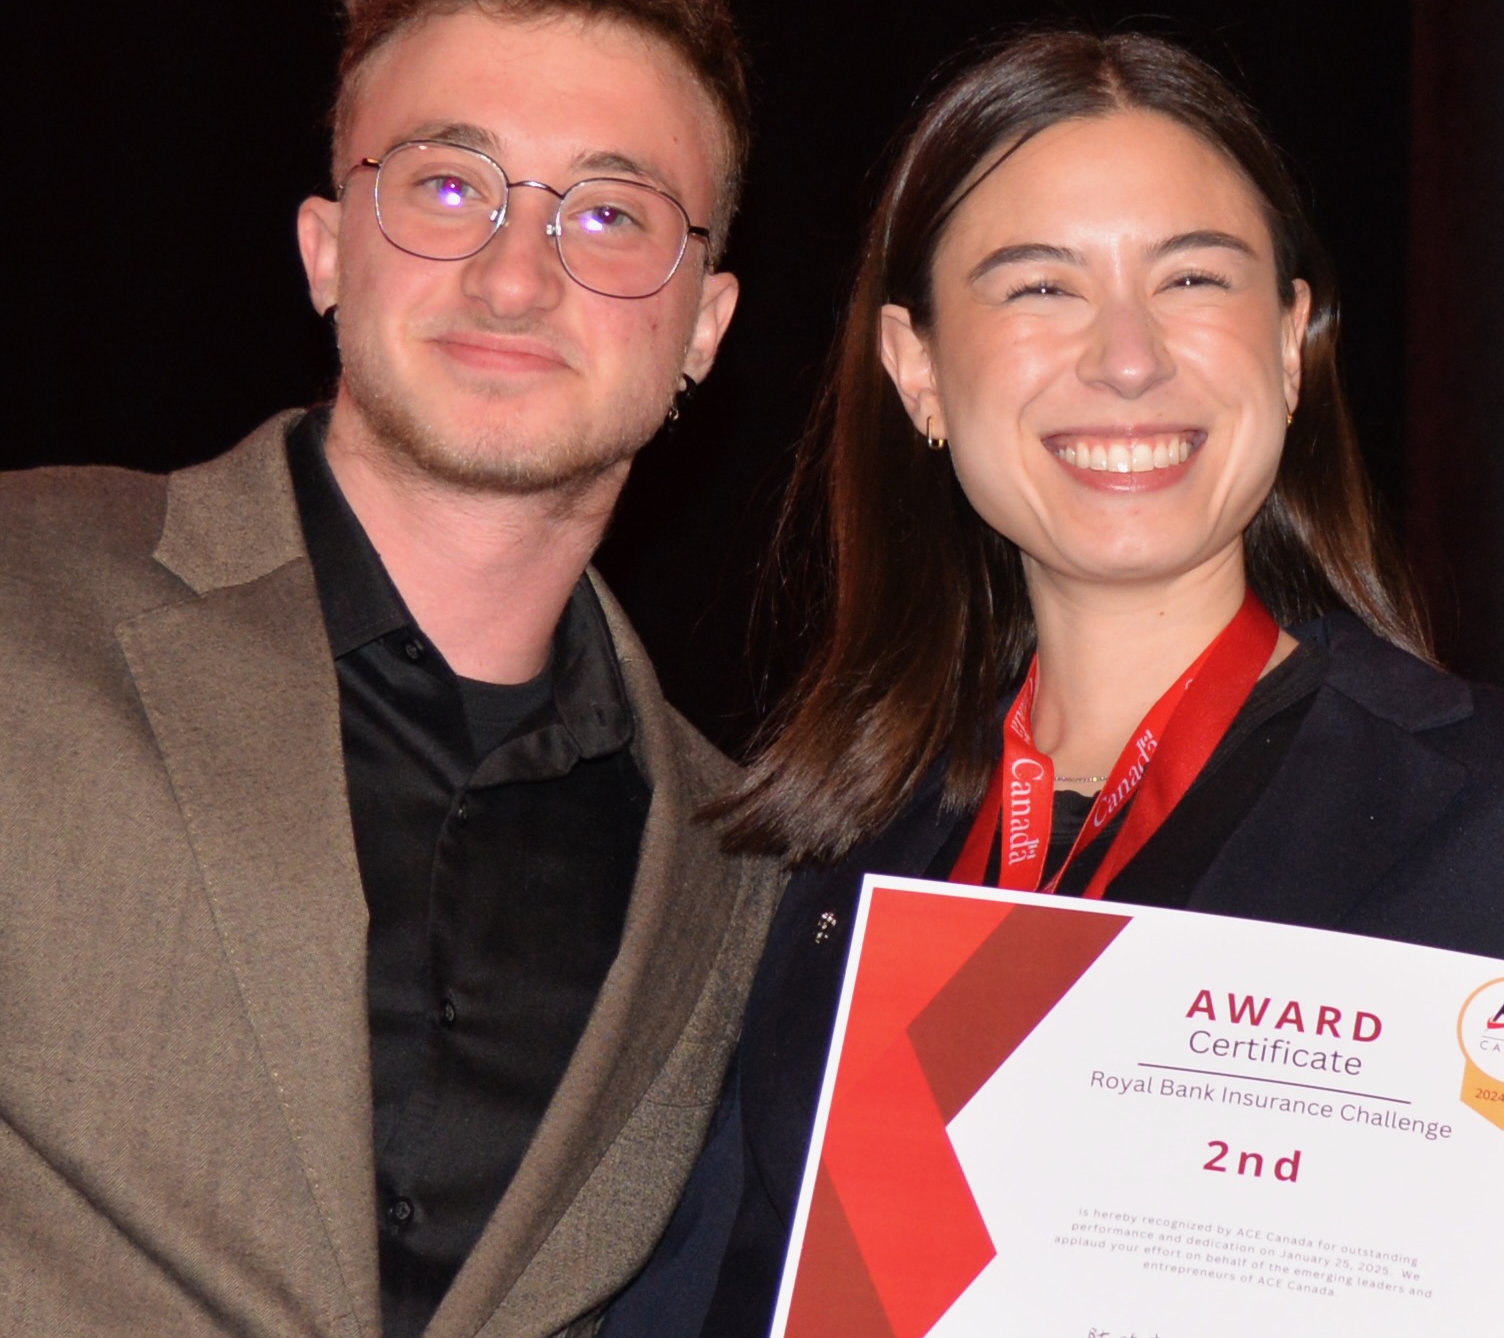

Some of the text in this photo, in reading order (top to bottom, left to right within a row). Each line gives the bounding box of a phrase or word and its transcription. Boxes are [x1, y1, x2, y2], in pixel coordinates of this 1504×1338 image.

[1009, 757, 1045, 866] Canada
[1186, 988, 1383, 1043] AWARD
[1188, 1029, 1363, 1076] Certificate
[1090, 1070, 1453, 1141] Royal Bank Insurance Challenge
[1202, 1140, 1301, 1183] 2nd
[1054, 1236, 1432, 1298] applaud your effort on behalf of the emerging leaders and
[1071, 1222, 1154, 1239] performance
[1158, 1233, 1182, 1243] and
[1186, 1236, 1255, 1254] dedication
[1260, 1247, 1275, 1256] on
[1280, 1250, 1331, 1267] January
[1335, 1258, 1353, 1270] 25,
[1401, 1270, 1420, 1281] We
[1079, 1208, 1418, 1267] is hereby recognized by ACE Canada for outstanding
[1143, 1261, 1235, 1282] entrepreneurs
[1240, 1274, 1252, 1283] of
[1258, 1277, 1282, 1288] ACE
